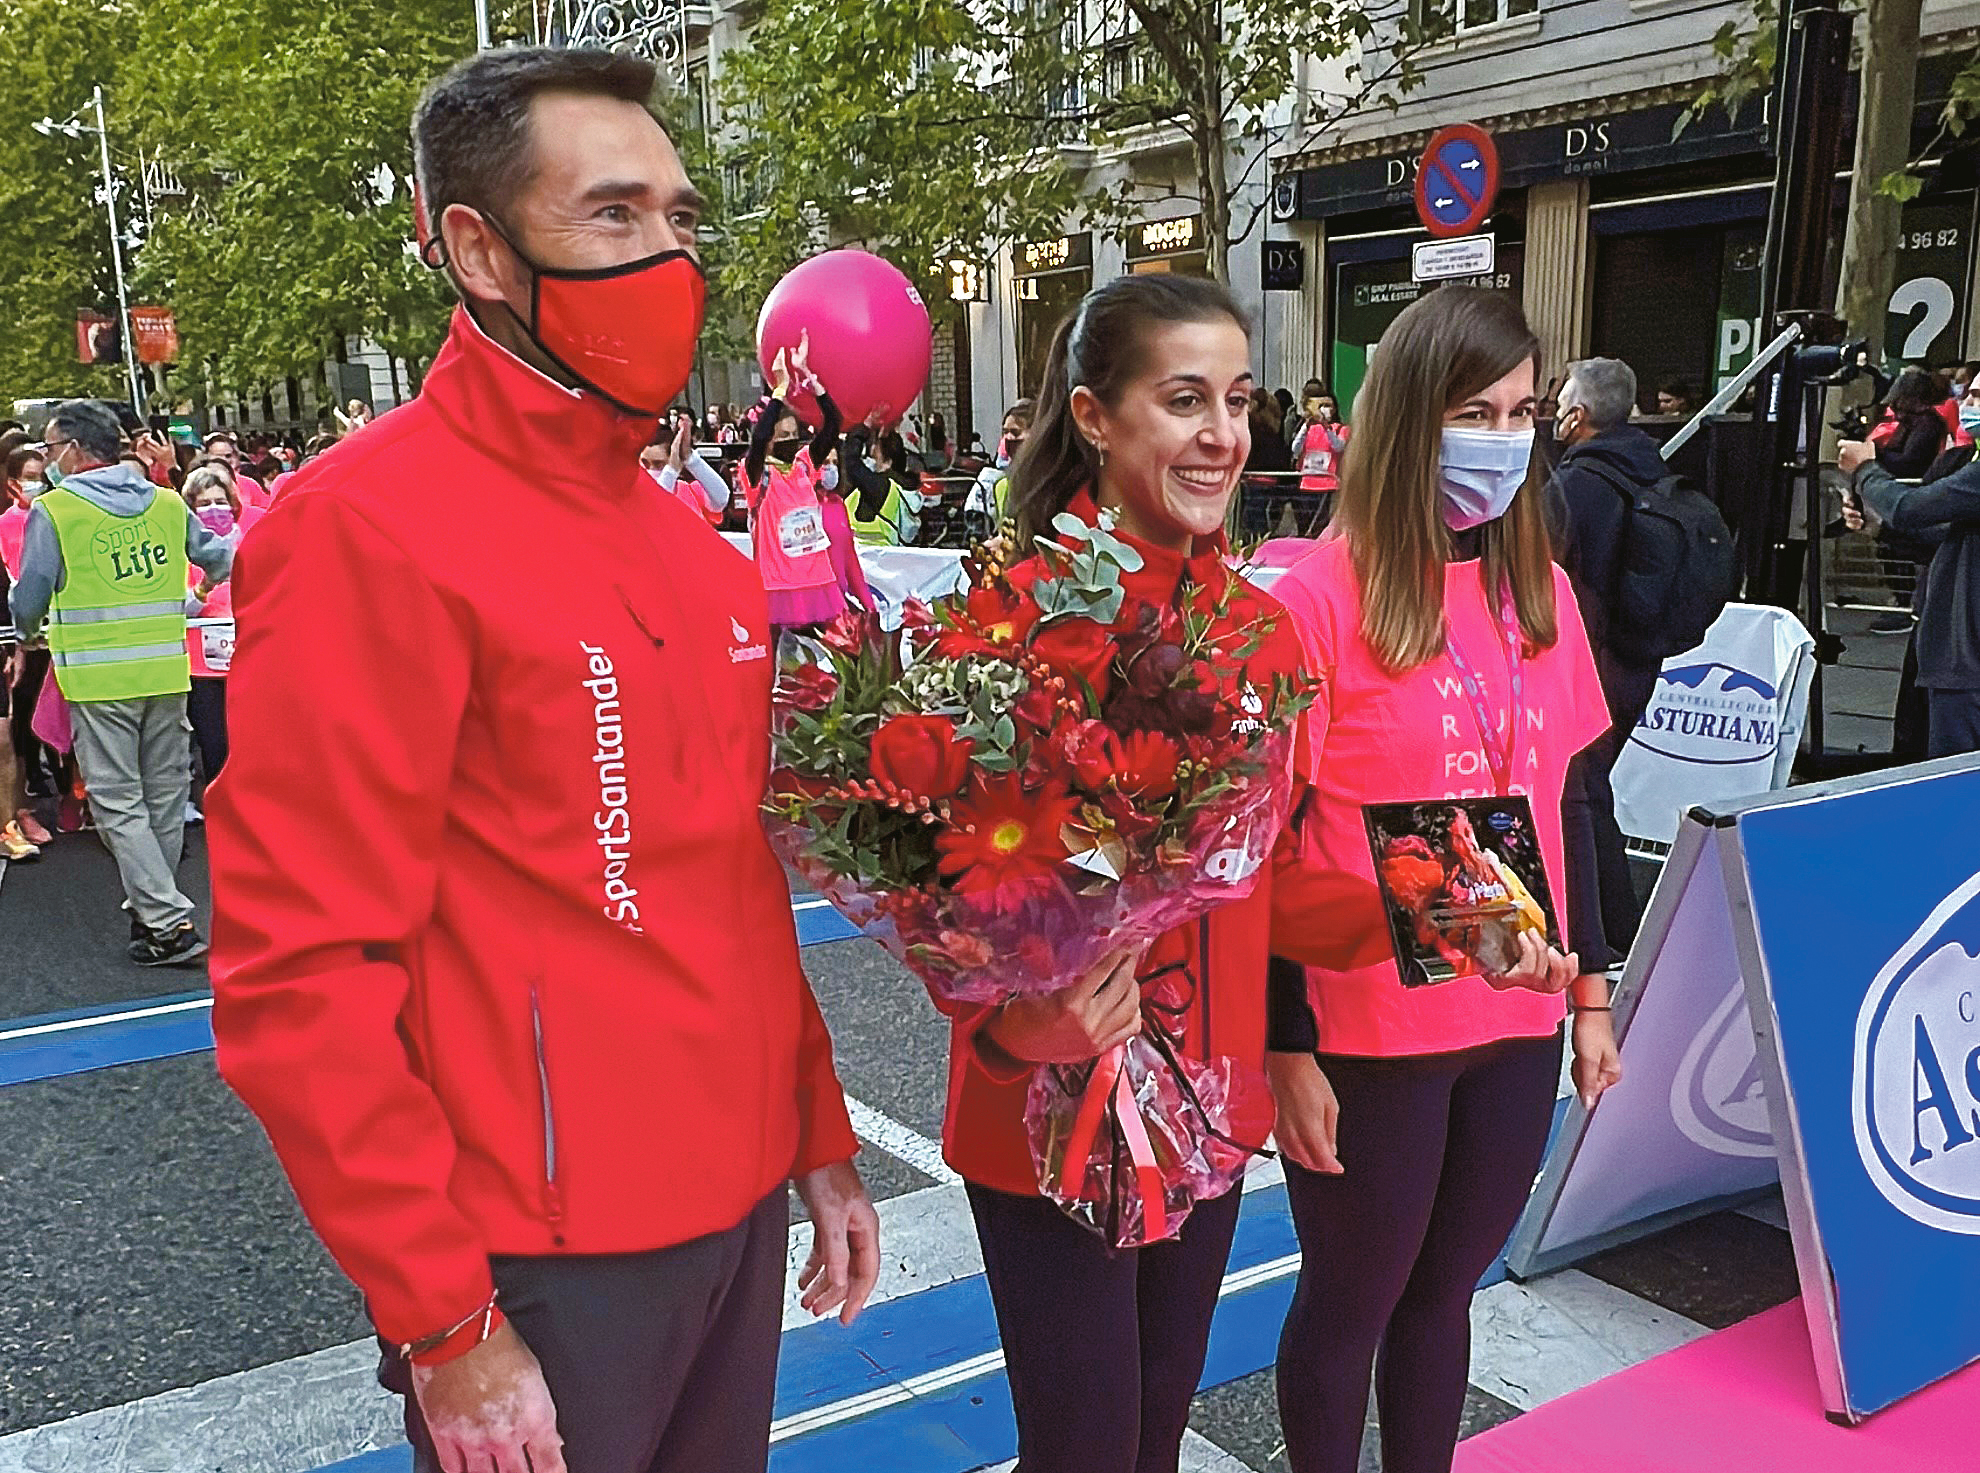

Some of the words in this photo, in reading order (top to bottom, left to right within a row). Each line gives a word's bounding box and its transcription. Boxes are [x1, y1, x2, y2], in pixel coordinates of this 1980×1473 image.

[1565, 122, 1610, 157] D'S
[1911, 231, 1932, 250] 96
[1937, 228, 1958, 247] 82
[95, 518, 152, 554] Sport
[111, 540, 168, 581] Life
[1526, 746, 1538, 769] A
